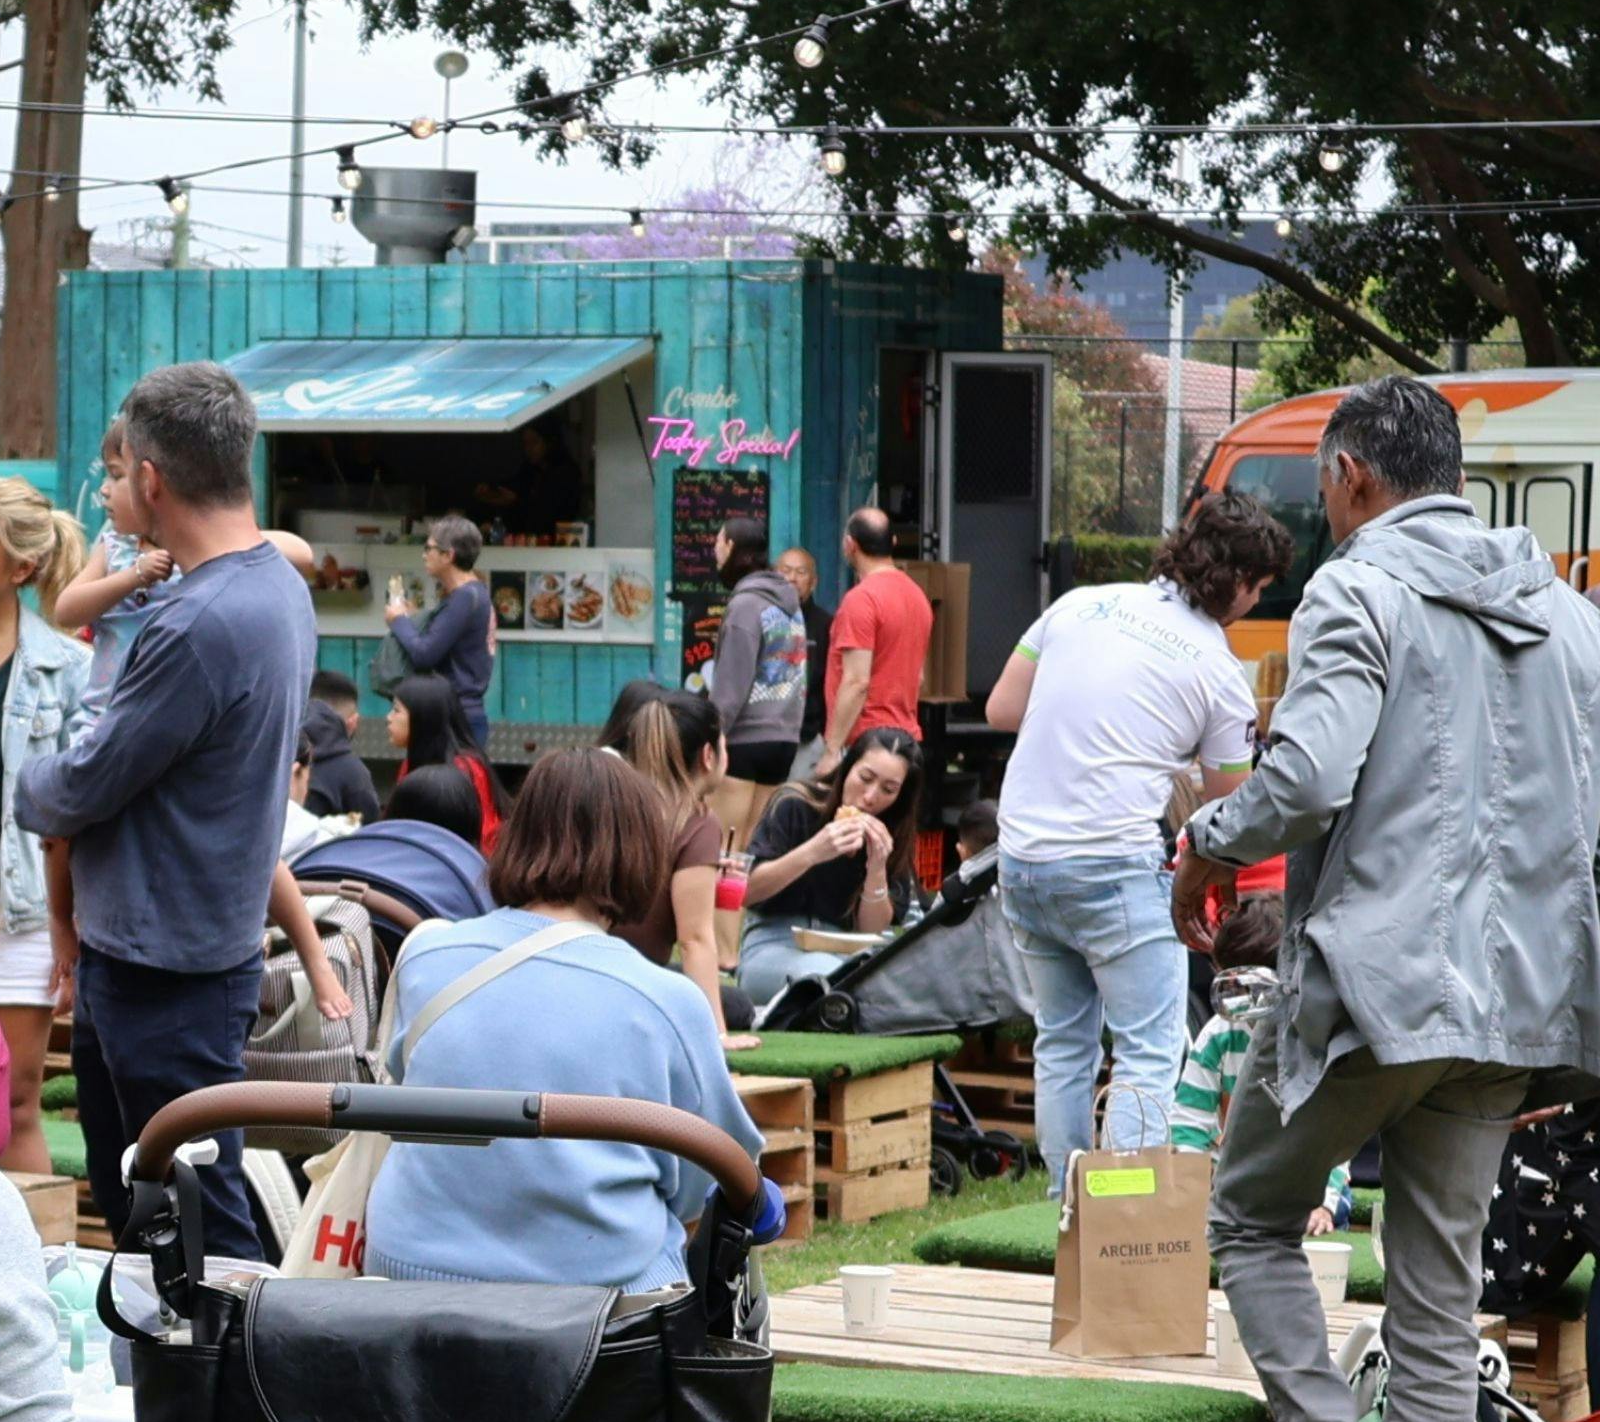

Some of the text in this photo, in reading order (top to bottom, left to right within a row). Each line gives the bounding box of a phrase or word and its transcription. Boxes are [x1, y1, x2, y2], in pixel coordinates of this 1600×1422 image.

[1113, 608, 1140, 623] MY
[1141, 620, 1204, 662] CHOICE
[1099, 1240, 1192, 1258] ARCHIE ROSE
